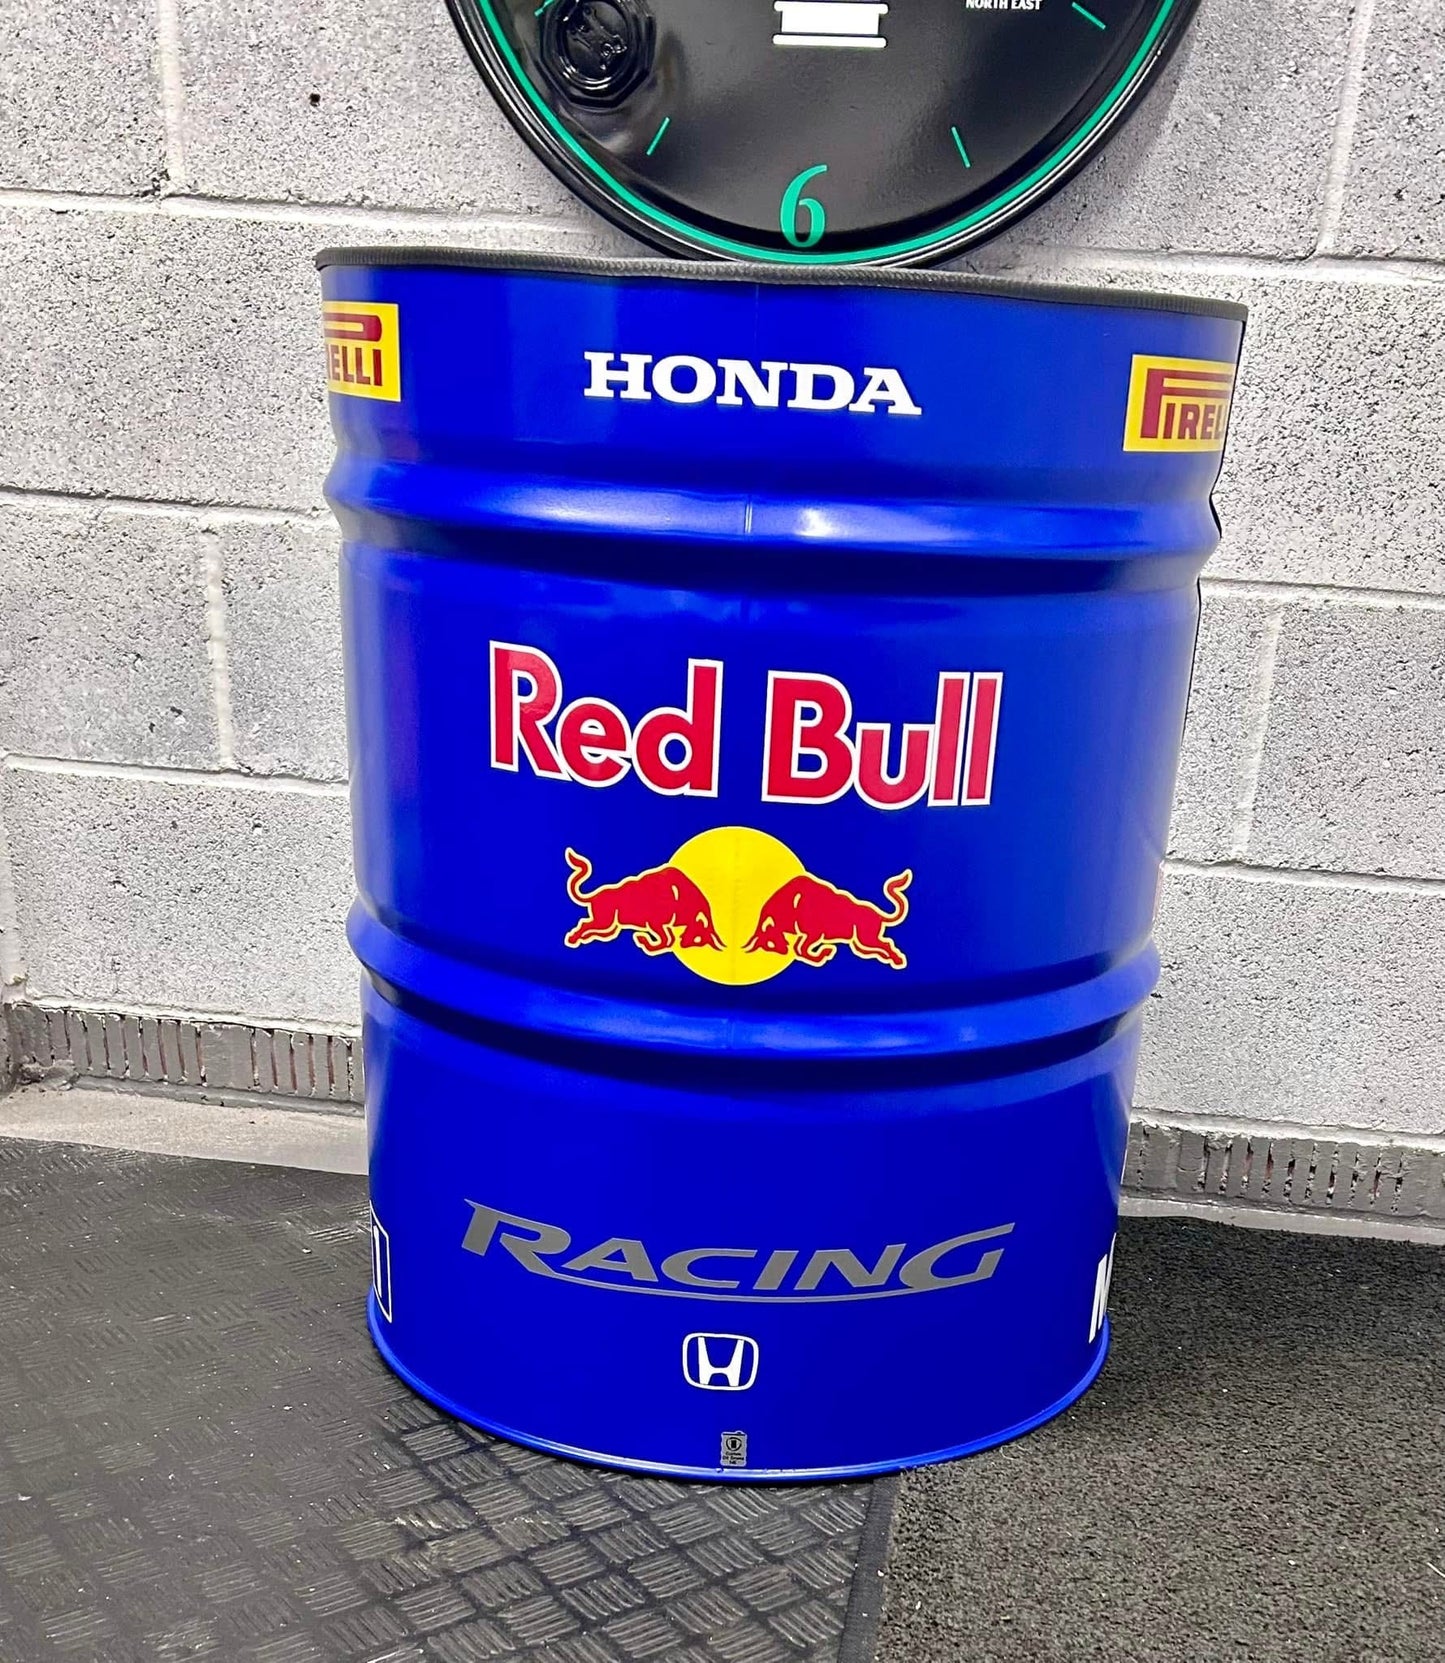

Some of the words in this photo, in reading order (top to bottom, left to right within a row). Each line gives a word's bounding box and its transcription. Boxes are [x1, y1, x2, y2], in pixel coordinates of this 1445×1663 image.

[966, 0, 1008, 9] NORTH
[1011, 0, 1042, 10] EAST
[781, 165, 827, 248] 6
[584, 351, 922, 415] HONDA
[1140, 368, 1233, 440] PIREL
[489, 640, 723, 797] Red
[761, 670, 1003, 810] Bull
[462, 1199, 1015, 1303] RACING
